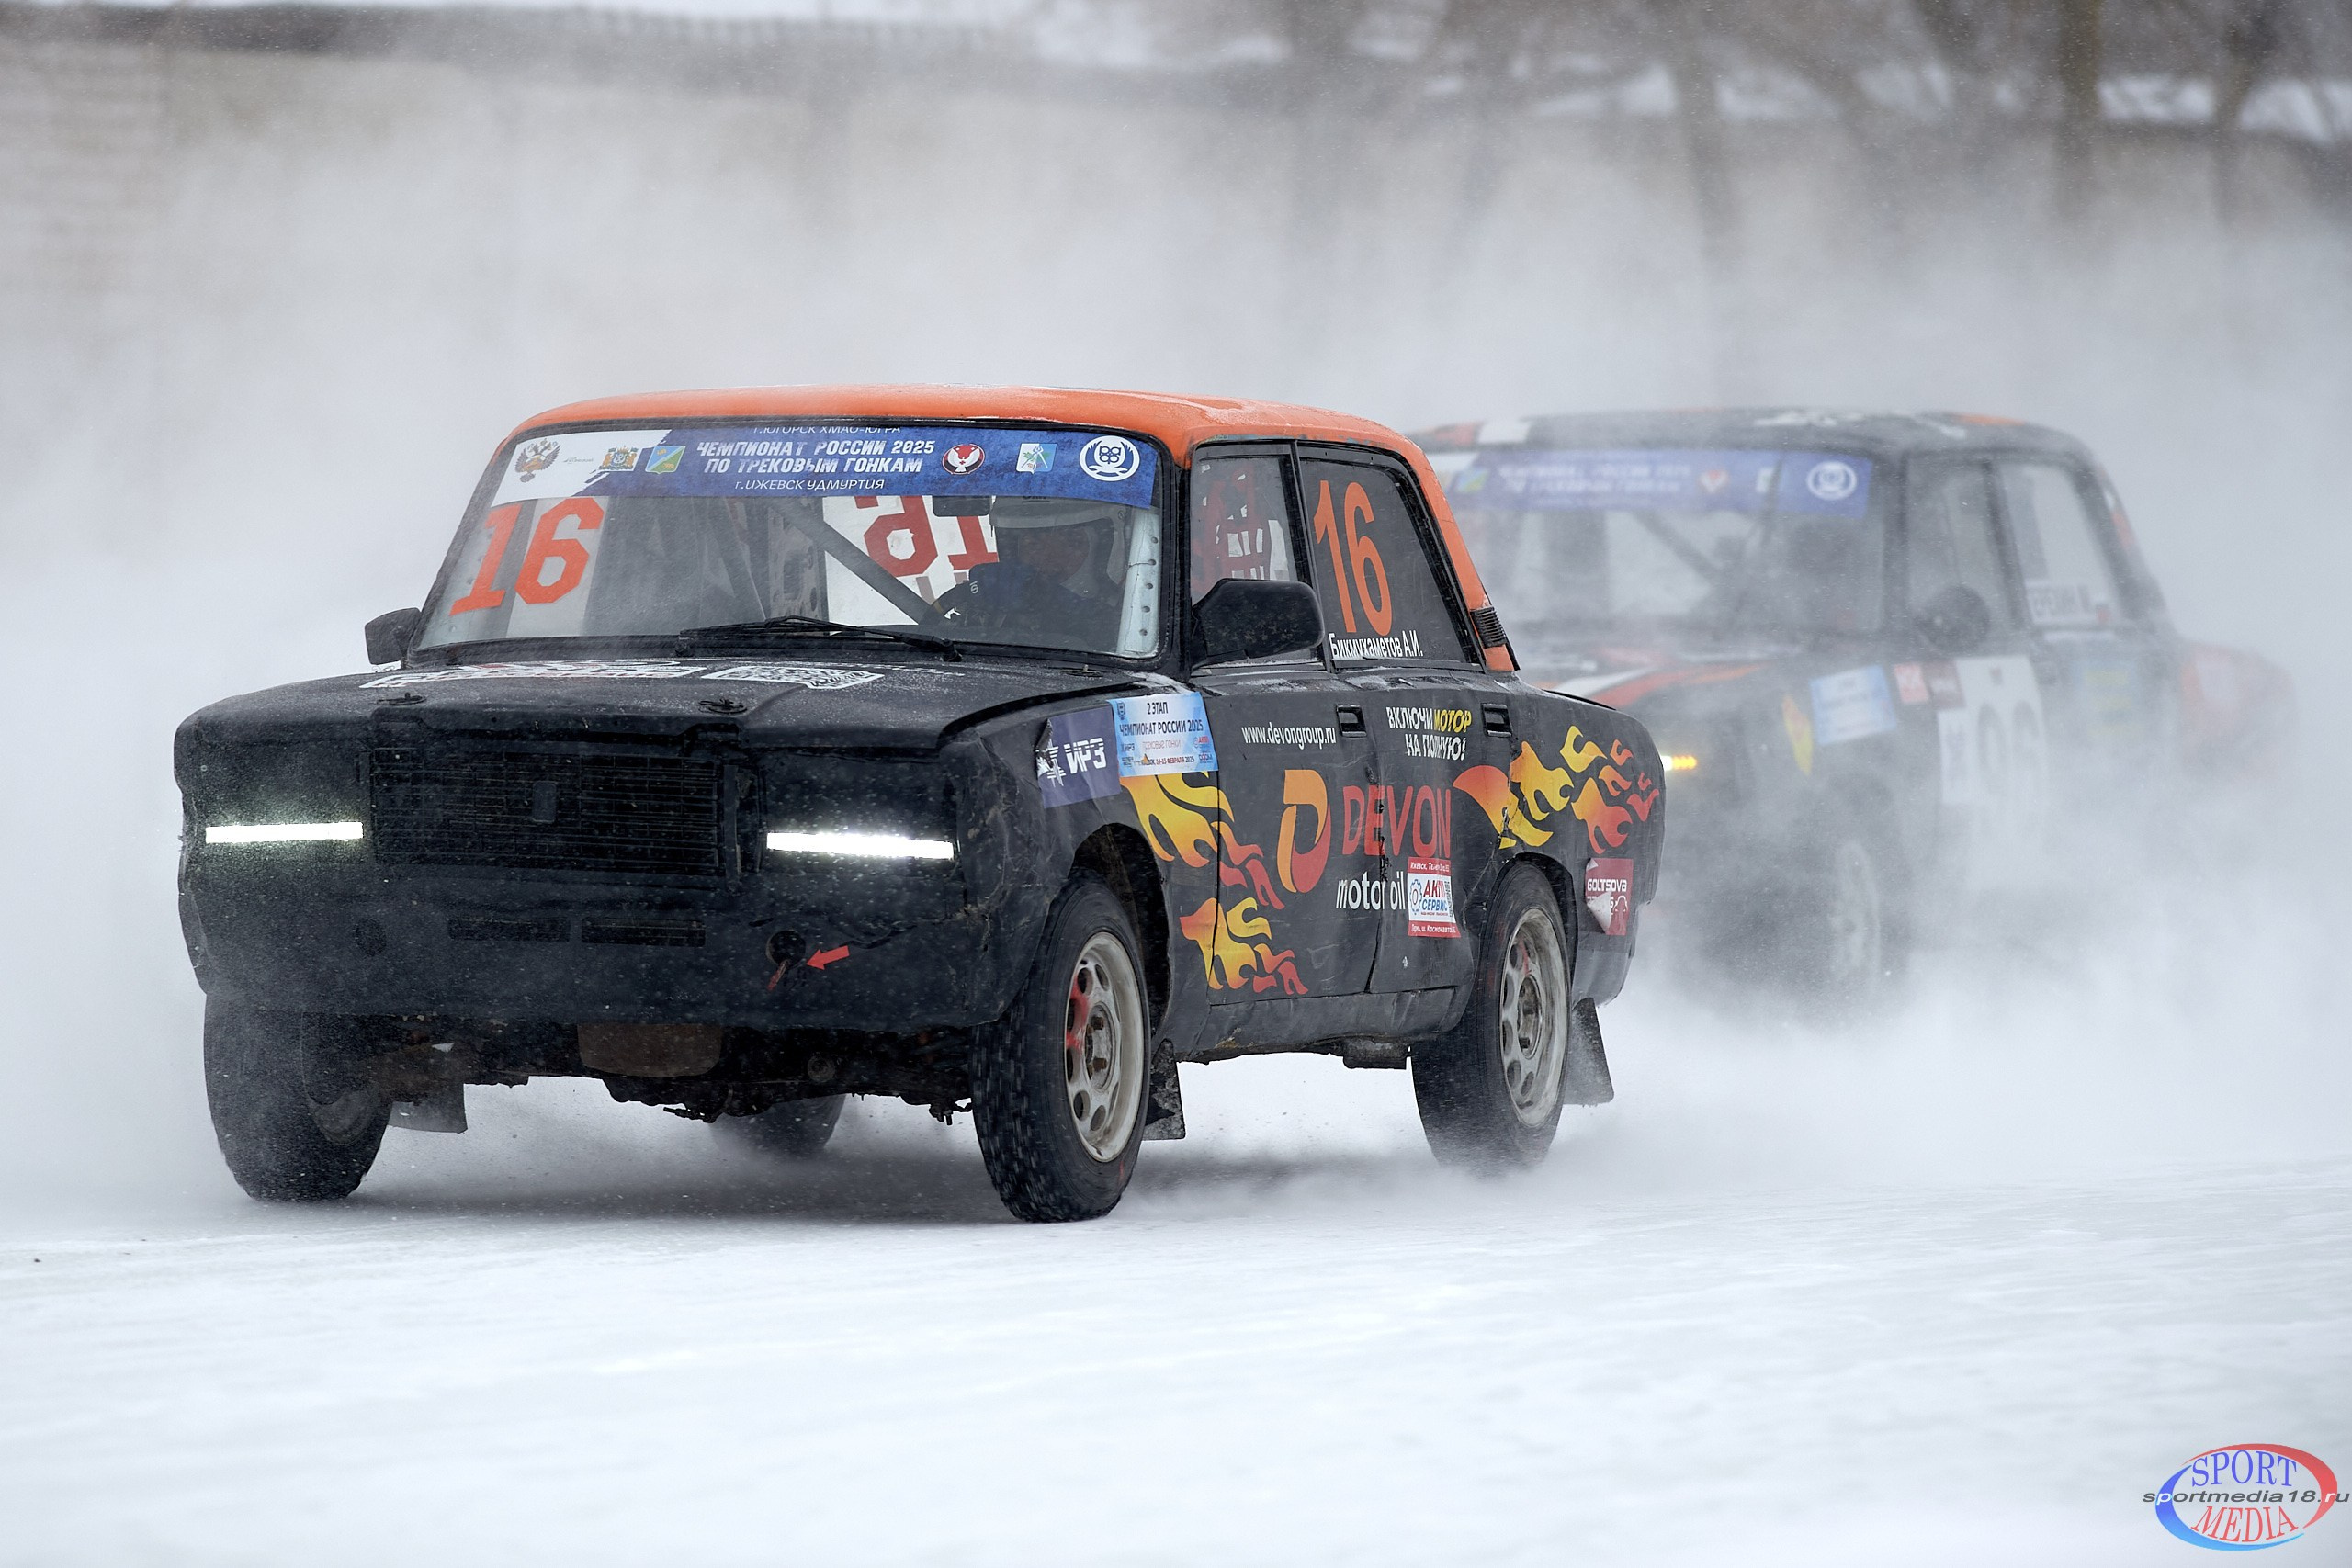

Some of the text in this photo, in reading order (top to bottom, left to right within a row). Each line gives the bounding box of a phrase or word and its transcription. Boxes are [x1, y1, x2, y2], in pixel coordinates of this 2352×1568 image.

[696, 440, 935, 457] ЧЕМПИОНАТ РОССИИ 2025
[704, 457, 923, 473] ПО ТРЕКОВЫМ ГОНКАМ
[807, 479, 885, 490] УДМУРТИЯ
[449, 497, 605, 617] 16
[1313, 480, 1392, 636] 16
[1329, 630, 1423, 660] Бикмухаметов А.И.
[1147, 702, 1169, 715] 2 ЭТАП
[1119, 719, 1204, 737] ЧЕМПИОНАТ РОССИИ 2025
[1241, 722, 1337, 750] www.devongroup.ru
[1065, 737, 1106, 774] ИРЗ
[1405, 734, 1466, 761] НА ПОЛНУЮ!
[1342, 785, 1452, 858] DEVON
[1336, 871, 1406, 910] motor oil
